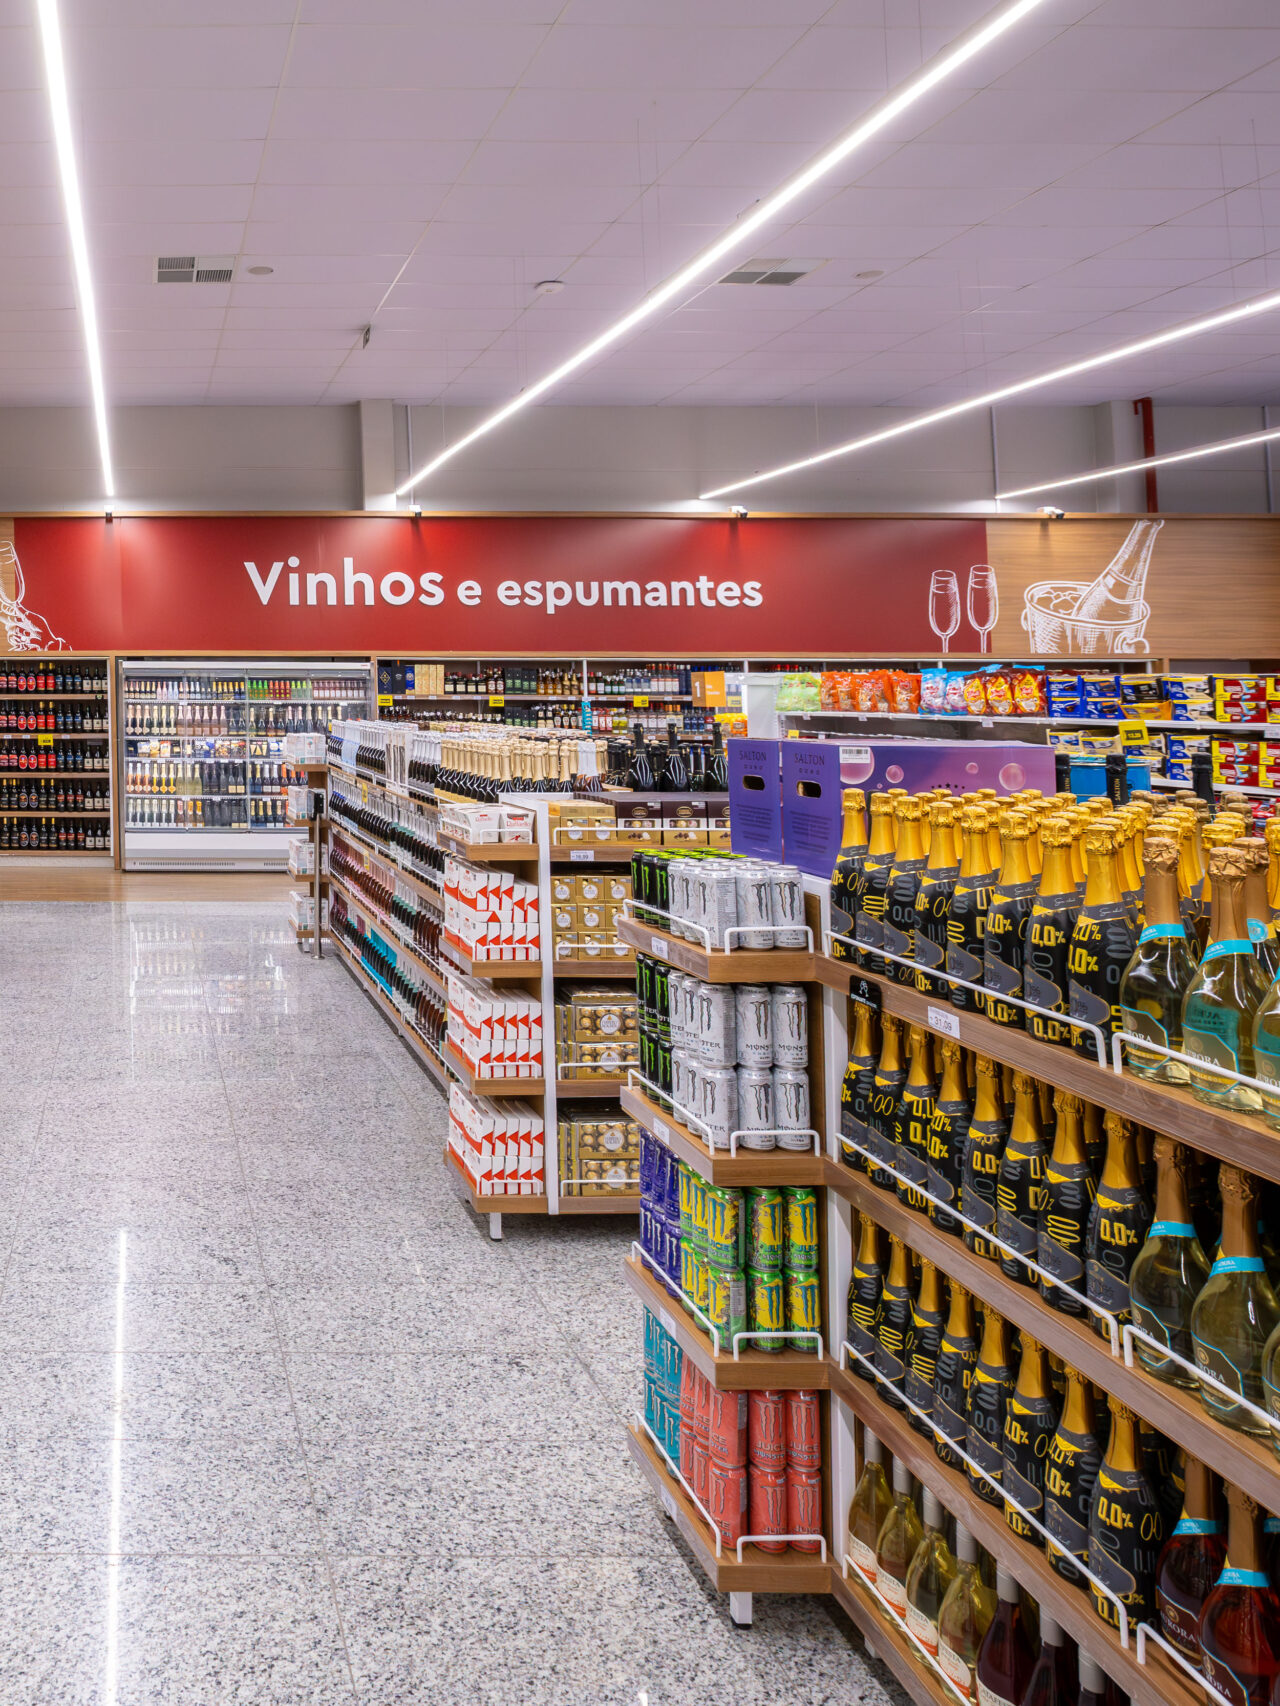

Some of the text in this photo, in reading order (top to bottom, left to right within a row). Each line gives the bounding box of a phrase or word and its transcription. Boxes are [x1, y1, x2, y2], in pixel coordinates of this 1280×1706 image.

[243, 556, 764, 615] Vinhos e espumantes
[694, 681, 701, 698] 1
[740, 750, 767, 761] SALTON
[794, 753, 825, 766] SALTON
[986, 912, 1013, 934] 0,0%
[1031, 923, 1066, 947] 0,0%
[986, 1002, 1018, 1022] 0,0%
[1034, 1017, 1071, 1042] 0,0%
[1099, 1217, 1138, 1248] 0,0%
[1097, 1495, 1135, 1530] 0,0%
